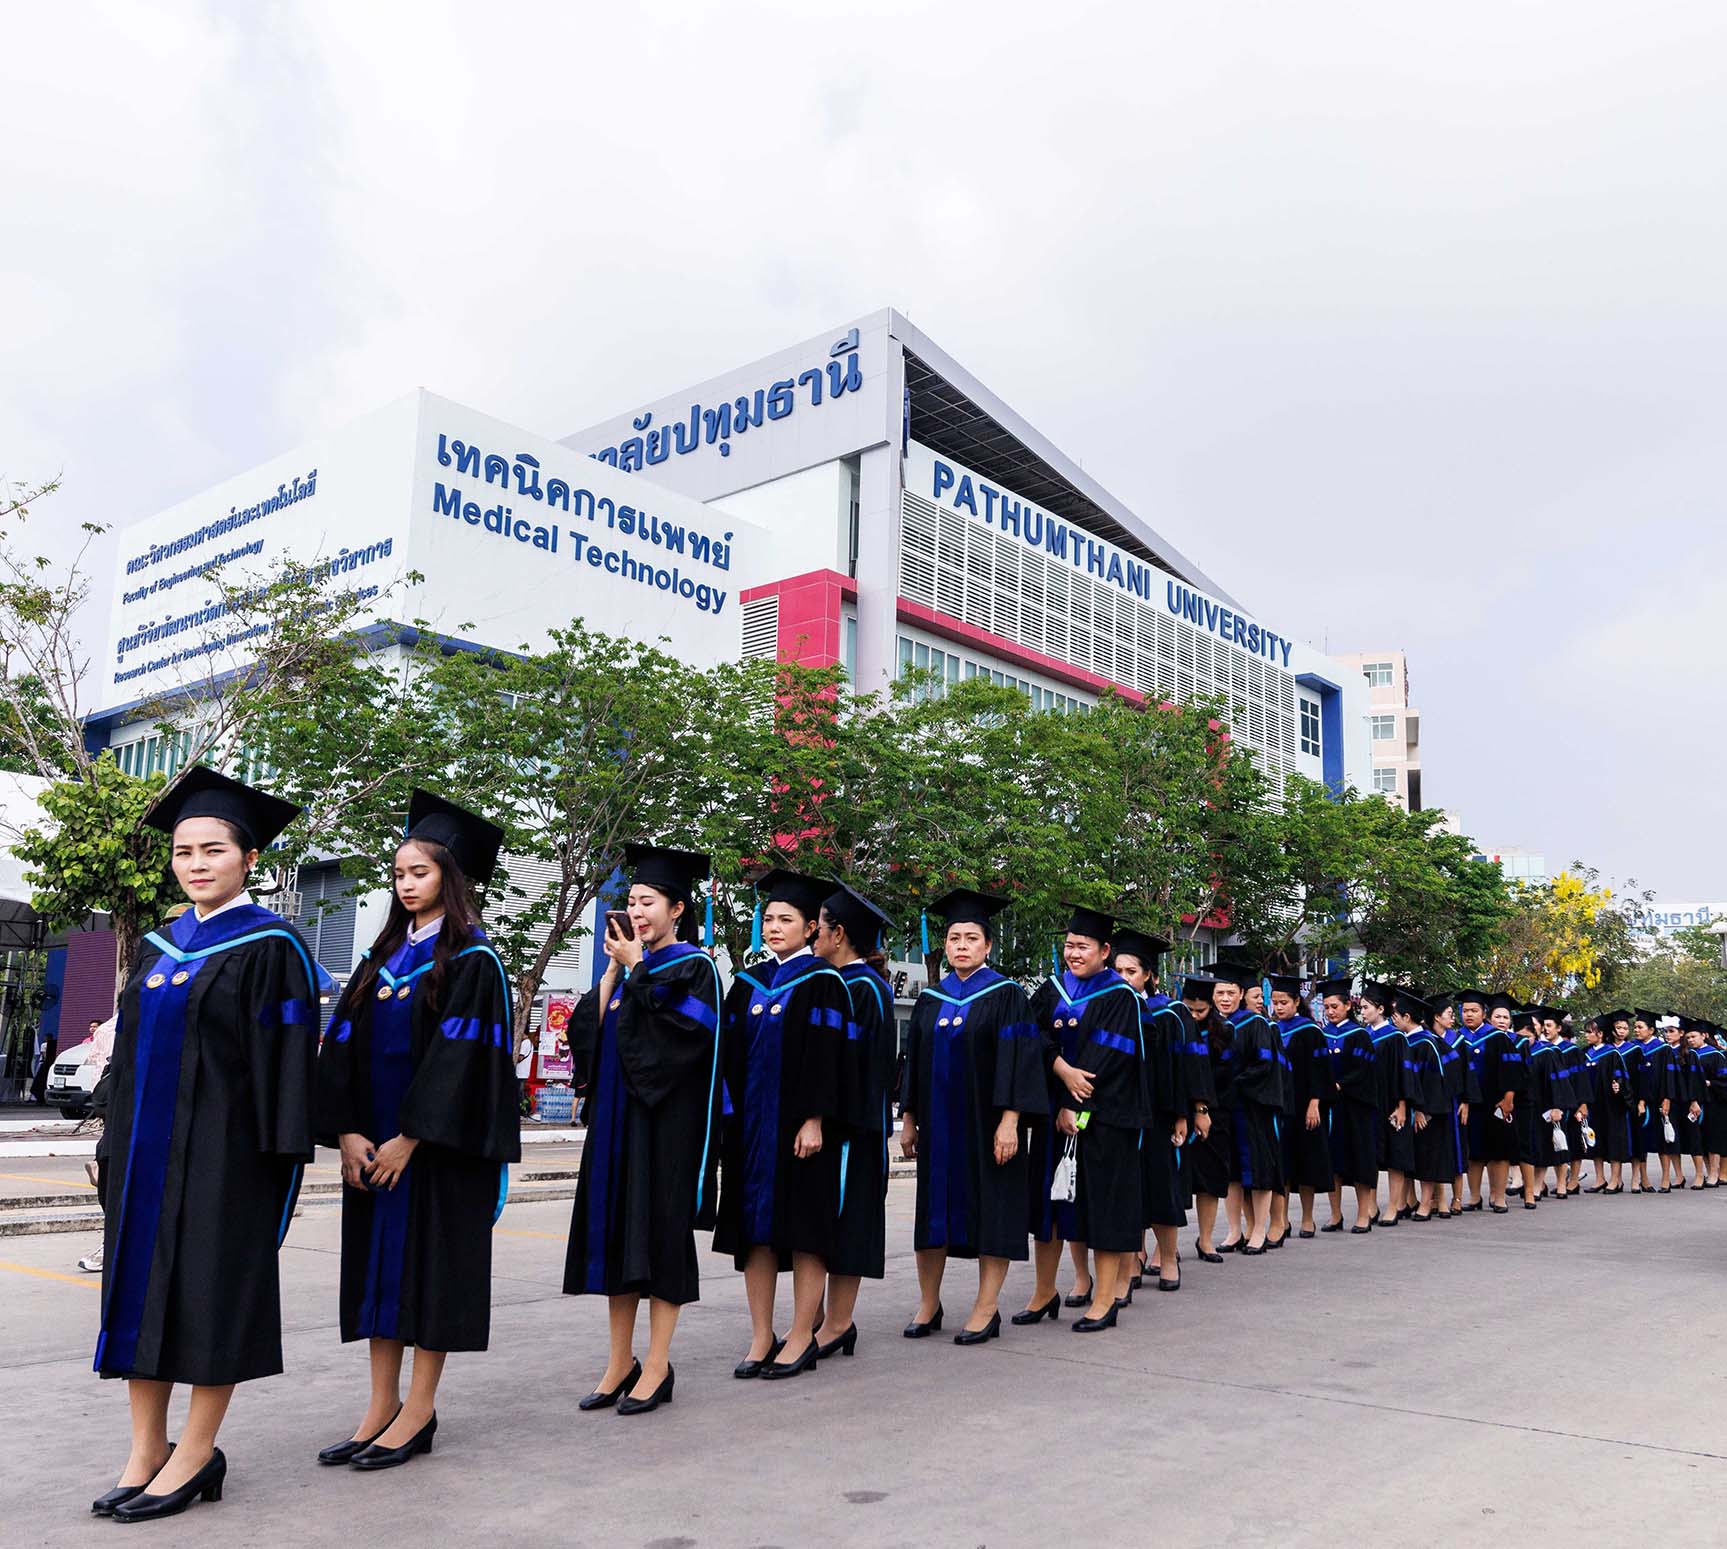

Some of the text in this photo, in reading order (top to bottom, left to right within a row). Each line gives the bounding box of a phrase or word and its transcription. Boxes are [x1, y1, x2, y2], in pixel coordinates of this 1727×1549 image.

[589, 328, 863, 473] าลัยปทุมธานี
[432, 482, 727, 614] Medical Technology
[437, 433, 734, 571] เทคนิคการแพทย์
[933, 460, 1293, 667] PATHUMTHANI UNIVERSITY
[123, 586, 149, 604] Faculty
[149, 580, 158, 594] of
[158, 564, 203, 590] Engineering
[216, 538, 265, 564] Technology
[114, 663, 147, 684] Research
[147, 653, 171, 672] Center
